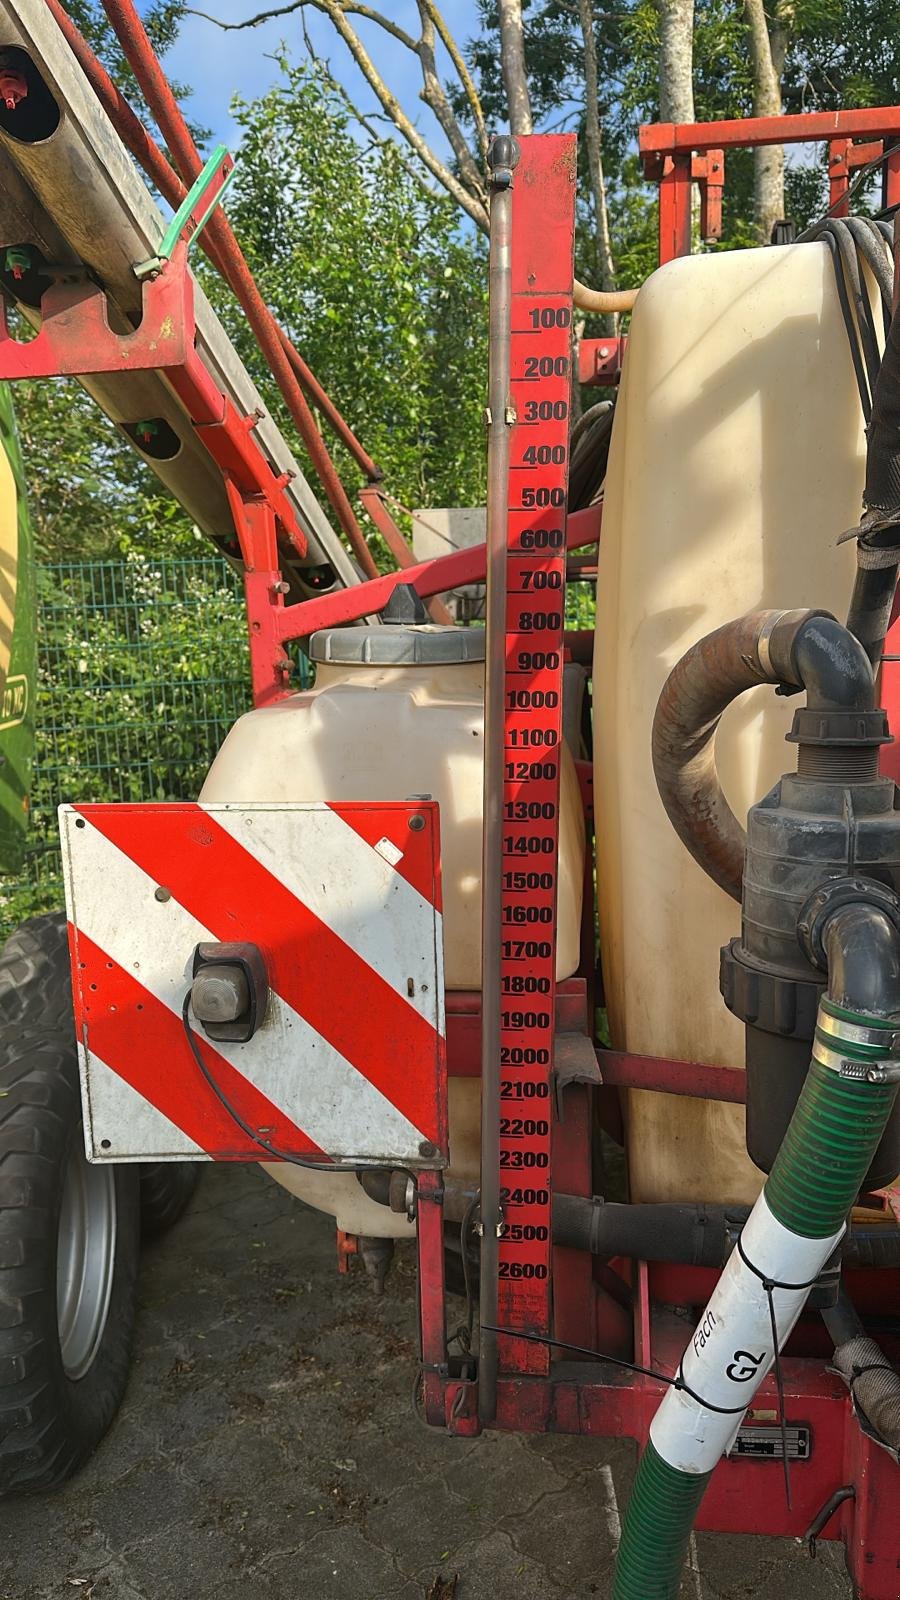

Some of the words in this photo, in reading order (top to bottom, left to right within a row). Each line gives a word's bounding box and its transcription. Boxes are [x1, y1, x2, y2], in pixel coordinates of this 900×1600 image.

[529, 308, 570, 328] 100
[525, 357, 568, 377] 200
[525, 401, 567, 420] 300
[523, 445, 565, 465] 400
[522, 488, 565, 507] 500
[520, 529, 563, 548] 600
[520, 571, 561, 589] 700
[519, 612, 560, 630] 800
[518, 652, 559, 670] 900
[507, 690, 558, 709] 1000
[508, 728, 557, 746] 1100
[506, 762, 556, 780] 1200
[505, 802, 555, 819] 1300
[504, 836, 554, 854] 1400
[503, 872, 553, 889] 1500
[503, 906, 552, 923] 1600
[502, 941, 551, 958] 1700
[501, 976, 550, 993] 1800
[501, 1012, 550, 1028] 1900
[500, 1047, 549, 1064] 2000
[500, 1081, 549, 1098] 2100
[500, 1119, 549, 1136] 2200
[500, 1151, 549, 1168] 2300
[500, 1187, 549, 1205] 2400
[500, 1225, 548, 1241] 2500
[499, 1262, 547, 1279] 2600
[693, 1309, 717, 1358] Fach
[726, 1350, 767, 1383] G2
